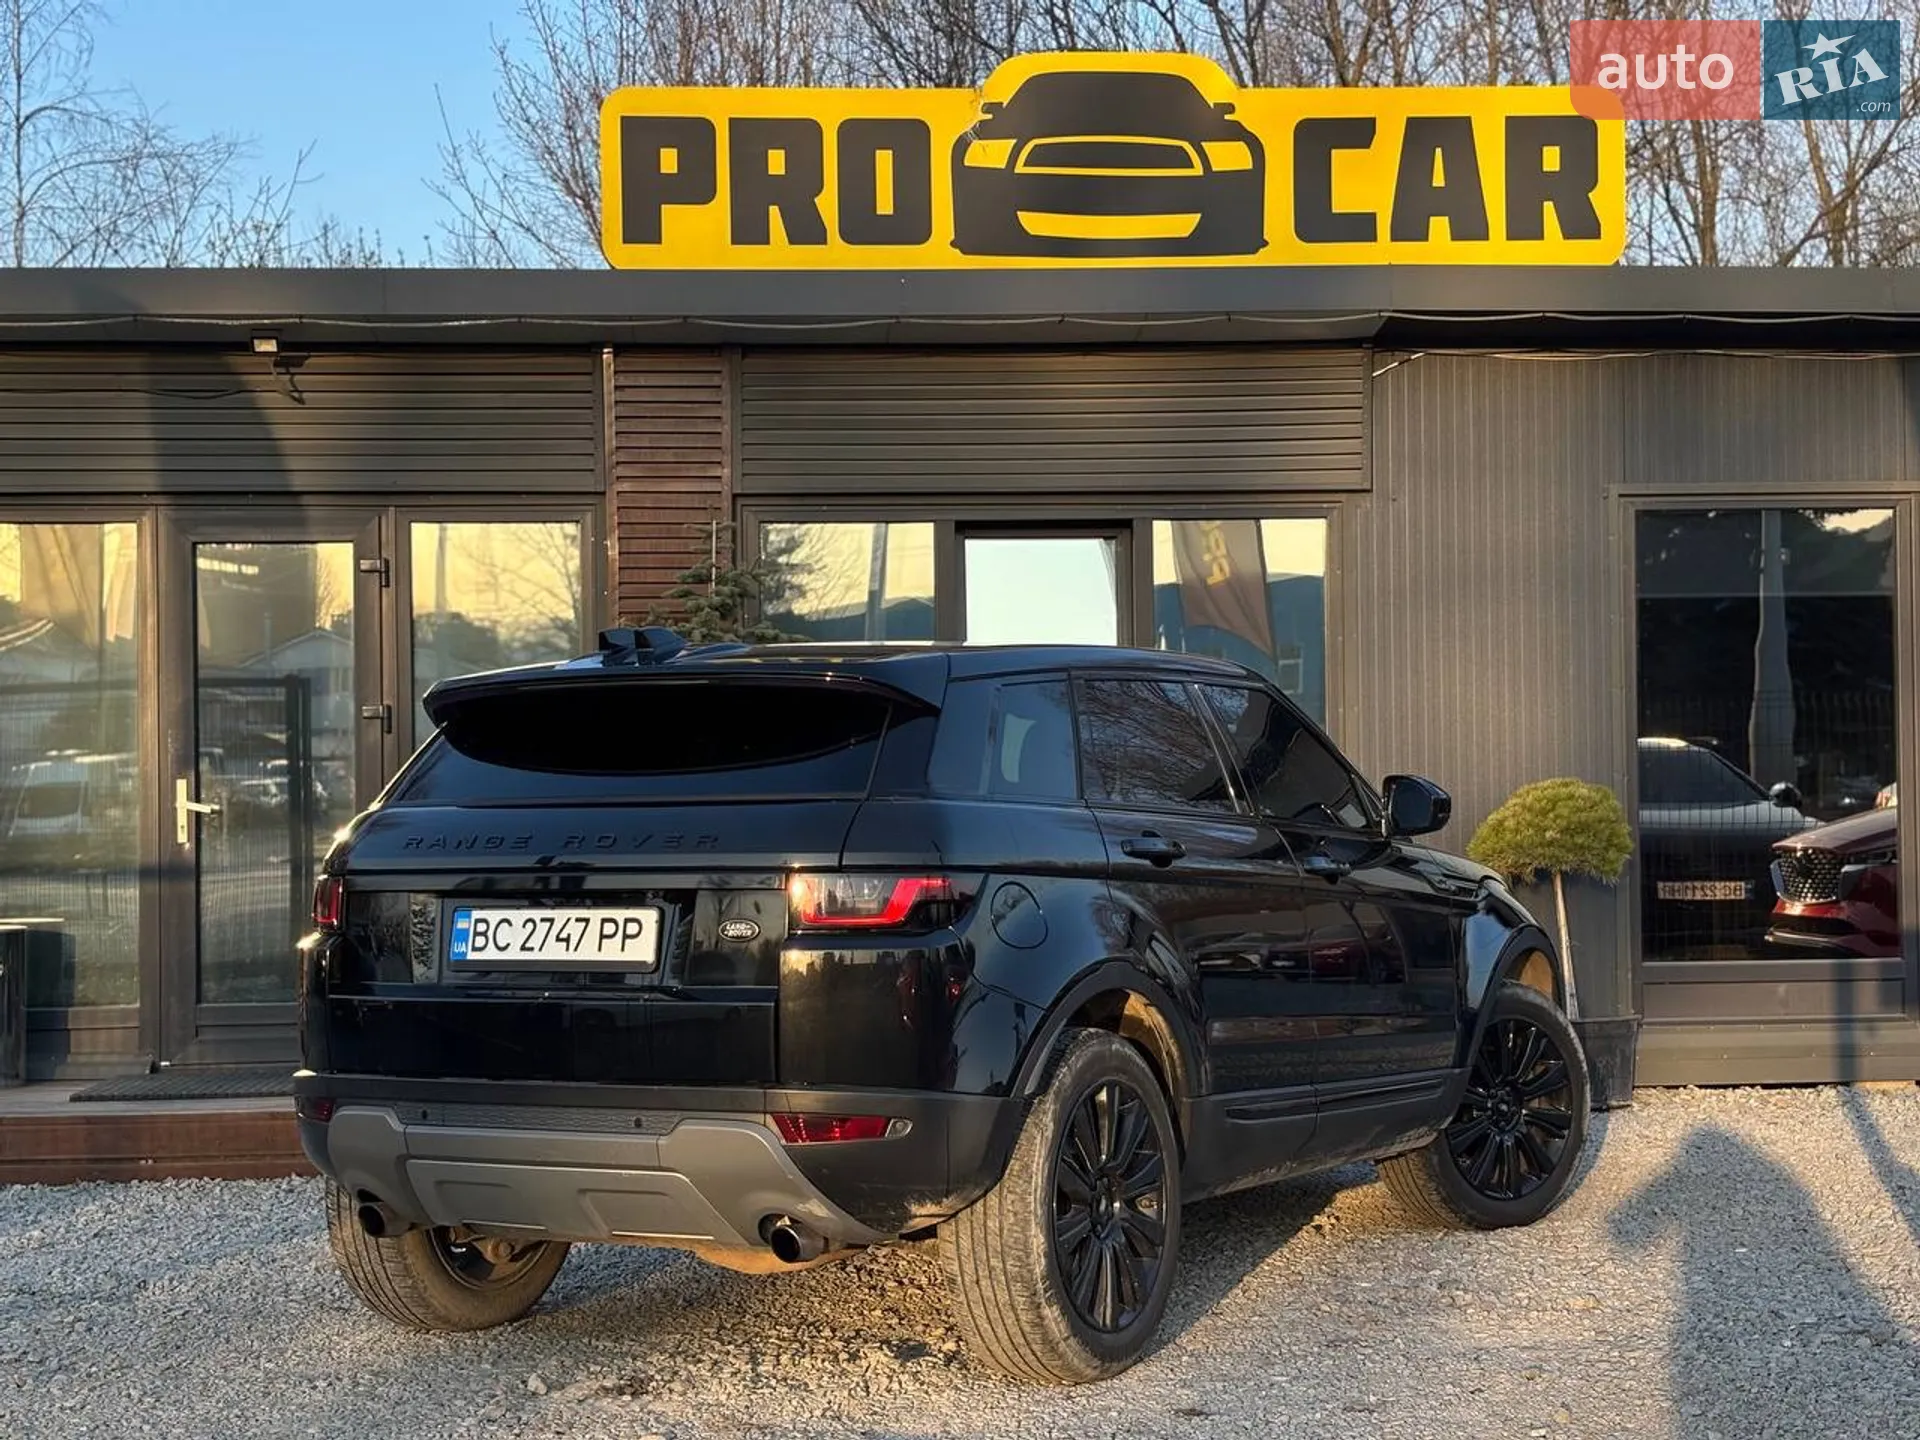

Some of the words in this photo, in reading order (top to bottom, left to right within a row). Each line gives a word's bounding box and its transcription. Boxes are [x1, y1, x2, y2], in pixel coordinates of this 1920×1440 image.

[620, 116, 932, 245] PRO
[1294, 115, 1602, 241] CAR
[402, 833, 533, 851] RANGE
[562, 832, 721, 850] ROVER
[454, 942, 467, 953] UA
[471, 917, 513, 952] BC
[520, 917, 591, 952] 2747
[598, 917, 643, 952] PP
